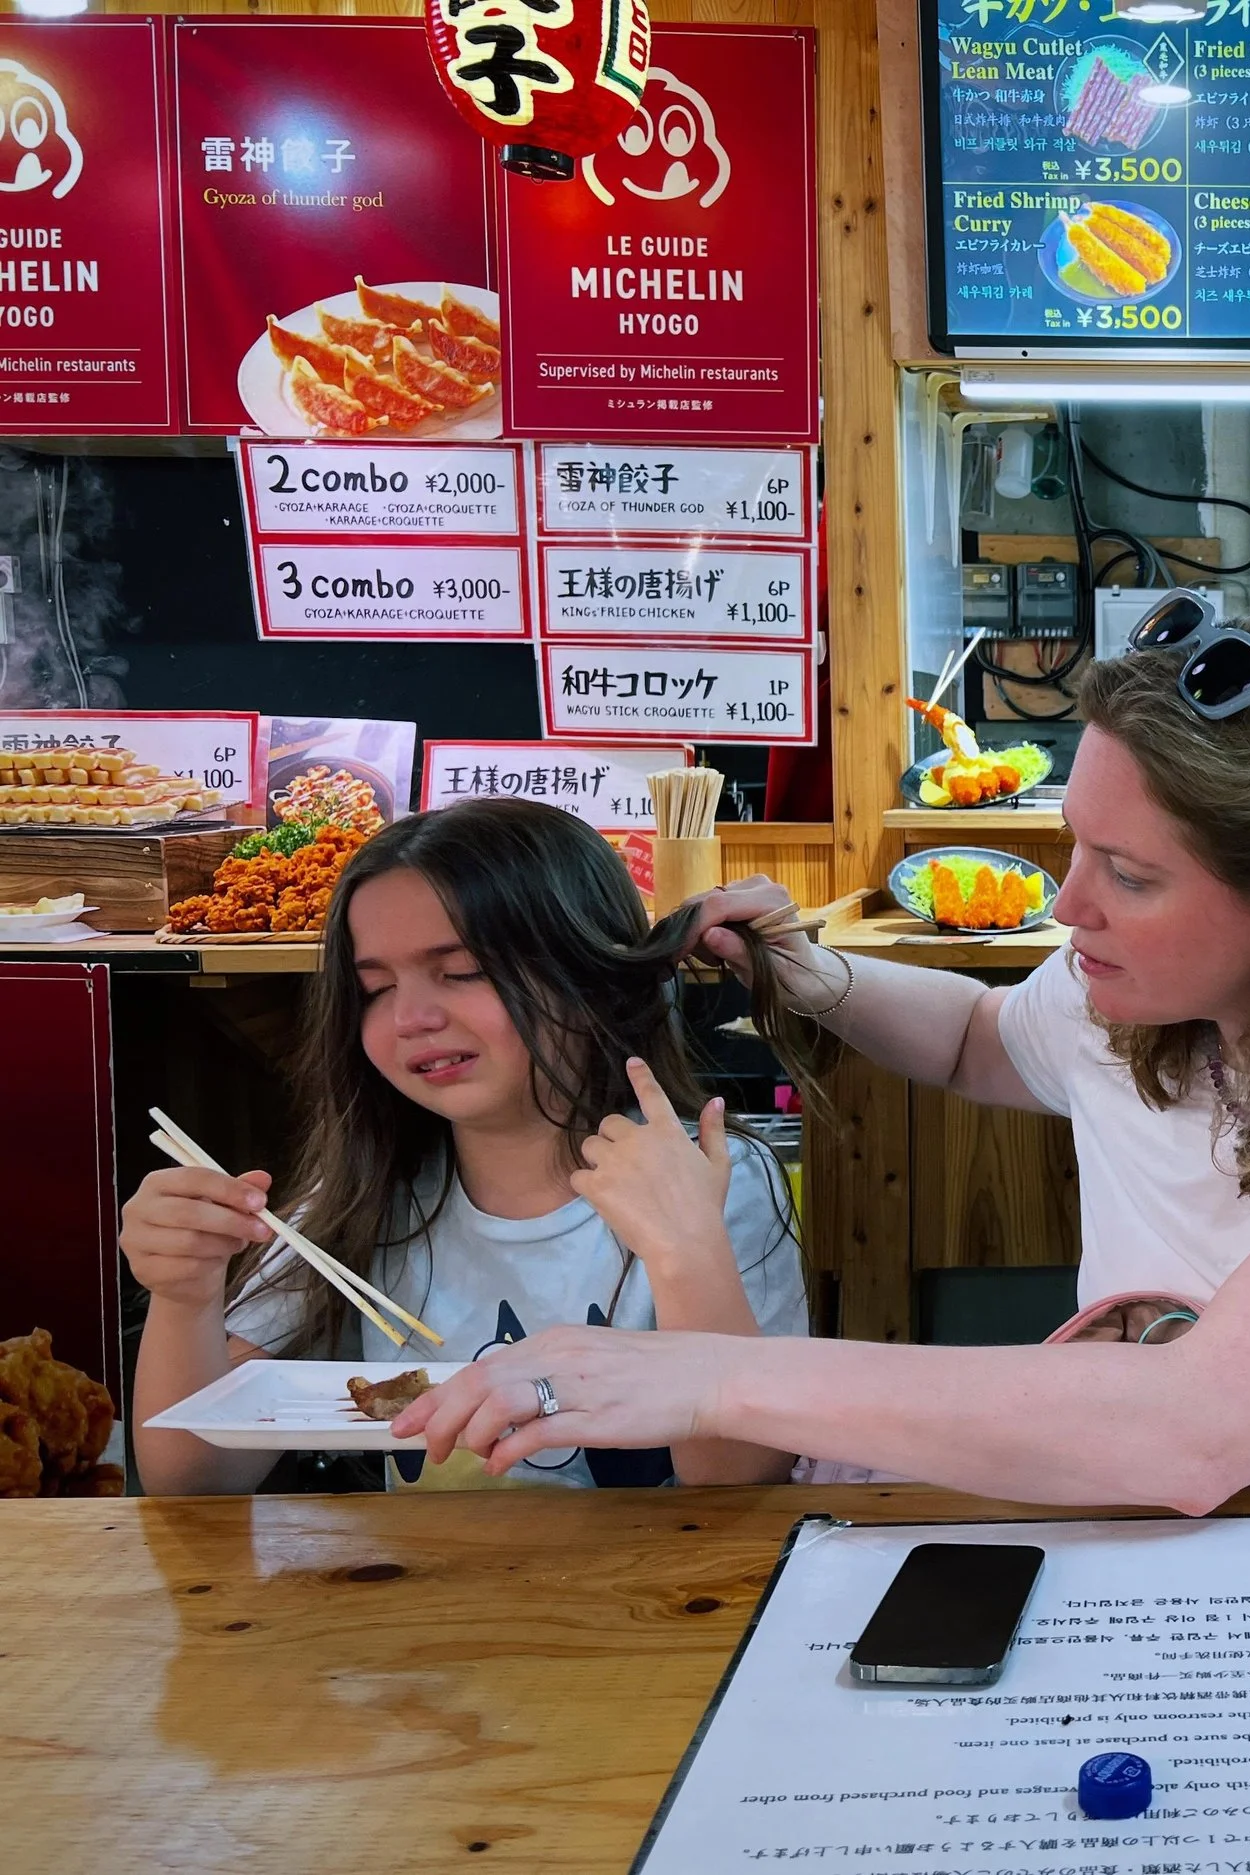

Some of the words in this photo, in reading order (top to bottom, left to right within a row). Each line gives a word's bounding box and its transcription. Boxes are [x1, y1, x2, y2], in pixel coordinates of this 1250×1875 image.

[951, 36, 1017, 58] Wagyu
[1023, 38, 1082, 56] Cutlet
[1194, 41, 1245, 58] Fried
[952, 63, 999, 80] Lean
[1005, 64, 1054, 80] Meat
[201, 136, 356, 173] 雷神餃子
[1074, 158, 1182, 182] ¥3,500
[203, 189, 256, 209] Gyoza
[261, 190, 280, 206] of
[282, 190, 347, 207] thunder
[352, 192, 384, 209] god
[954, 191, 1004, 208] Fried
[1010, 192, 1081, 213] Shrimp
[954, 215, 1012, 236] Curry
[0, 228, 62, 248] GUIDE
[607, 236, 632, 256] LE
[641, 237, 708, 257] GUIDE
[955, 240, 1045, 252] エビフライカレー
[571, 267, 744, 301] MICHELIN
[619, 314, 699, 335] HYOGO
[1076, 305, 1182, 329] ¥3,500
[57, 358, 136, 372] restaurants
[539, 362, 615, 381] Supervised
[620, 364, 636, 381] by
[640, 364, 696, 380] Michelin
[700, 365, 779, 381] restaurants
[608, 399, 713, 411] ミシュラン掲載店監修
[426, 473, 505, 497] ¥2,000-
[557, 462, 679, 494] 雷神餃子
[767, 478, 789, 494] 6P
[601, 501, 616, 512] OF
[622, 501, 676, 513] THUNDER
[680, 503, 704, 513] GOD
[726, 500, 795, 523] ¥1,100-
[277, 561, 302, 599] 3
[311, 569, 414, 599] combo
[433, 578, 511, 602] ¥3,000-
[557, 566, 724, 603] 王様の唐揚げ
[768, 581, 790, 596] 6P
[601, 607, 636, 618] FRIED
[639, 608, 695, 619] CHICKEN
[727, 603, 796, 625] ¥1,100-
[561, 665, 718, 700] 和牛コロッケ
[769, 681, 789, 695] 1P
[567, 705, 600, 716] WAGYU
[605, 706, 639, 717] STICK
[644, 706, 715, 719] CROQUETTE
[726, 702, 795, 723] ¥1,100-
[214, 747, 236, 762] 6P
[441, 766, 610, 798] 王様の唐揚げ
[1154, 1598, 1199, 1607] 사용은
[1109, 1615, 1156, 1625] 구입해
[1165, 1614, 1195, 1623] 이상
[1170, 1632, 1218, 1642] 구입한
[1114, 1713, 1148, 1723] only
[1153, 1712, 1223, 1721] restroom
[954, 1740, 994, 1749] item.
[1000, 1739, 1029, 1747] one
[1035, 1738, 1070, 1747] least
[1096, 1734, 1168, 1745] purchase
[979, 1788, 1009, 1798] and
[1184, 1780, 1219, 1792] only
[740, 1795, 787, 1805] other
[794, 1793, 834, 1804] from
[840, 1789, 928, 1802] purchased
[934, 1789, 972, 1799] food
